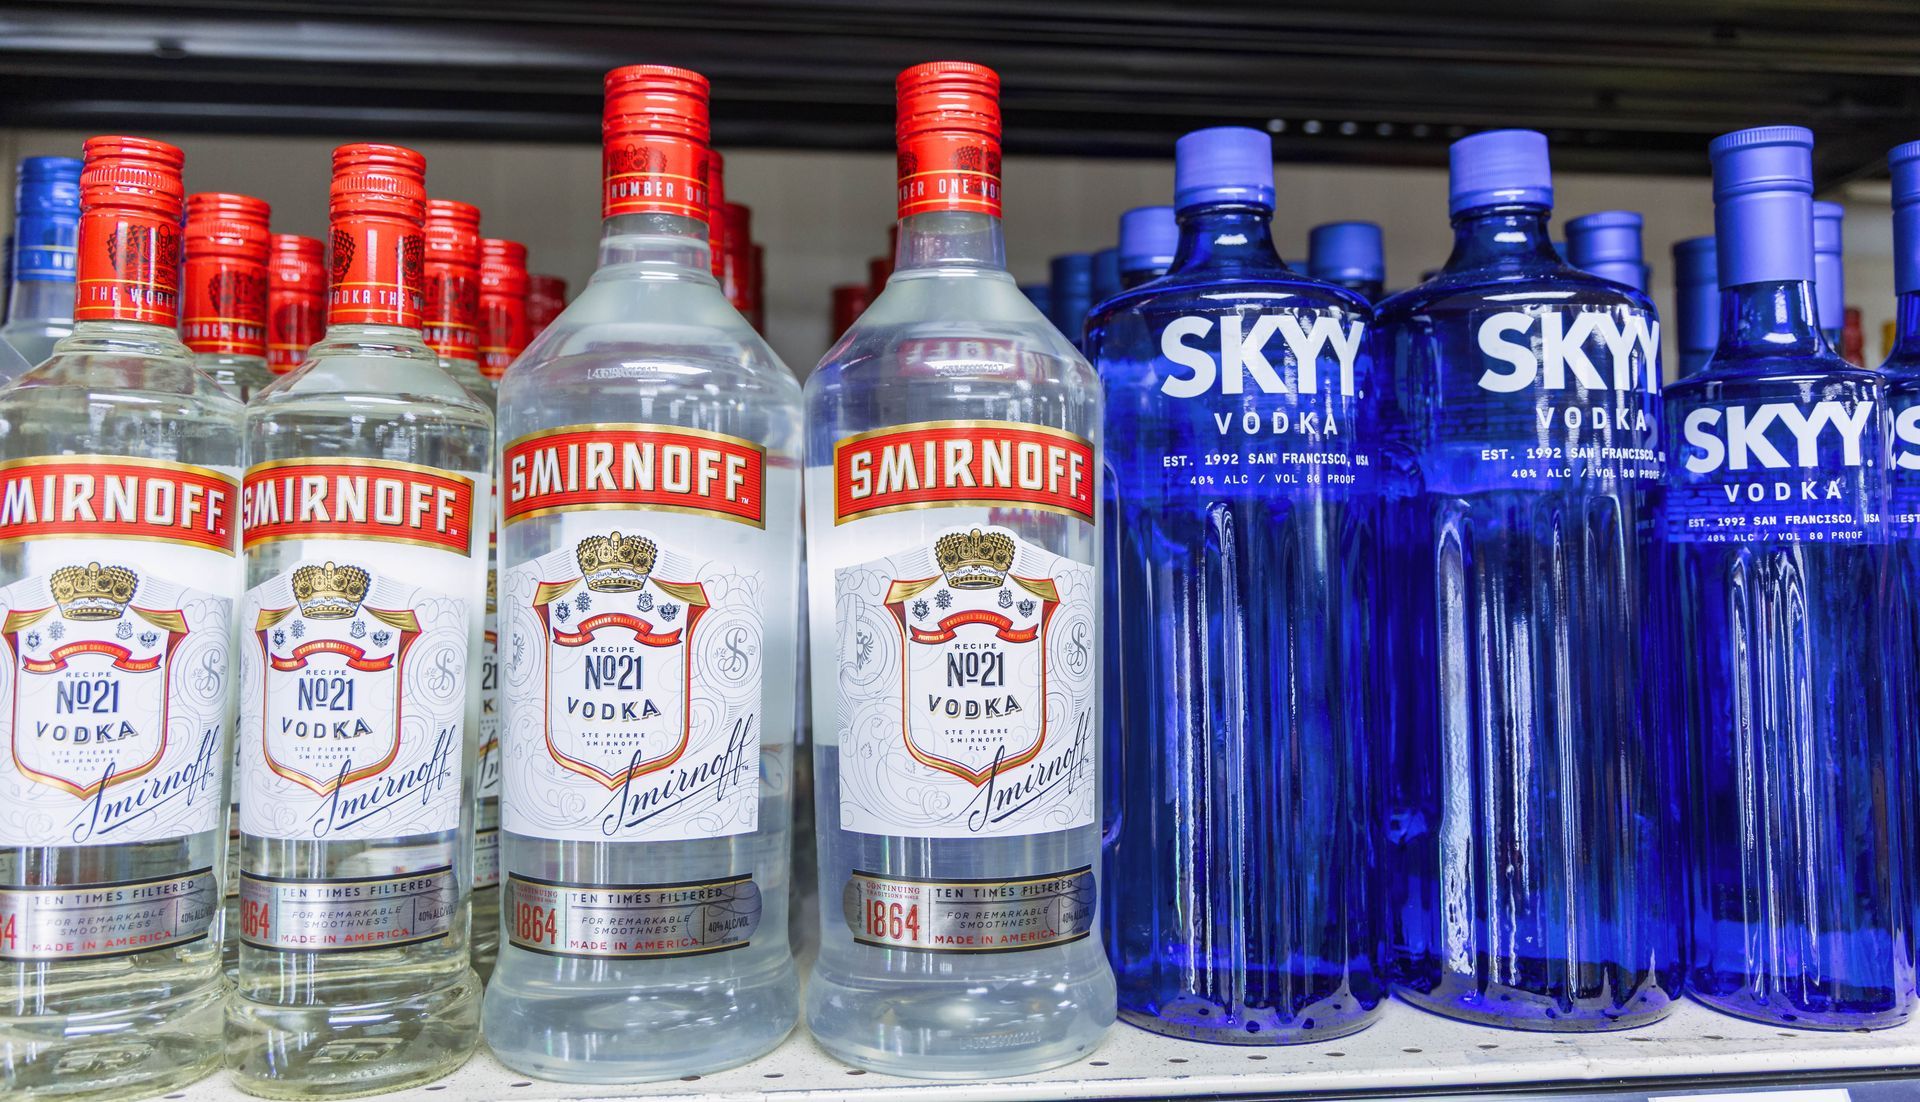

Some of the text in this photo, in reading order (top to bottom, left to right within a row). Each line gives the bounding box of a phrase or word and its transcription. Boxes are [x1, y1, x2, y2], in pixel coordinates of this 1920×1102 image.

[612, 181, 673, 198] NUMBER
[939, 178, 968, 194] ONE
[91, 286, 118, 301] THE
[380, 290, 405, 307] THE
[1161, 314, 1365, 398] SKYY
[1477, 311, 1660, 394] SKYY
[1214, 412, 1338, 435] VODKA
[1536, 407, 1647, 431] VODKA
[1683, 401, 1873, 474] SKYY
[1164, 453, 1369, 467] EST. 1992 SAN FRANCISCO, USA
[1481, 449, 1515, 461] EST.
[1526, 448, 1562, 459] 1992
[1570, 448, 1595, 459] SAN
[1602, 448, 1657, 463] FRANCISCO,
[512, 442, 746, 503] SMIRNOFF
[851, 439, 1084, 500] SMIRNOFF
[1511, 469, 1537, 478] 40%
[1547, 469, 1571, 478] ALC
[1595, 469, 1616, 478] VOL
[1623, 469, 1635, 479] 80
[1639, 469, 1660, 480] PROOF
[1190, 474, 1355, 485] 40% ALC / VOL 80 PROOF
[1724, 481, 1842, 502] VODKA
[243, 475, 456, 533] SMIRNOFF
[1688, 513, 1880, 528] EST. 1992 SAN FRANCISCO, USA
[1707, 534, 1726, 543] 40%
[1733, 533, 1755, 542] ALC
[1779, 532, 1801, 541] VOL
[1810, 532, 1823, 540] 80
[1832, 531, 1863, 540] PROOF
[567, 697, 661, 721] VODKA
[928, 694, 1022, 719] VODKA
[36, 720, 138, 744] VODKA
[282, 717, 373, 740] VODKA
[597, 714, 756, 836] Smirnoff
[961, 707, 1091, 831] Smirnoff
[65, 725, 220, 843] Smirnoff
[306, 725, 457, 838] Smirnoff
[35, 880, 195, 905] TEN TIMES FILTERED
[282, 888, 307, 898] TEN
[317, 888, 360, 898] TIMES
[370, 879, 432, 896] FILTERED
[572, 888, 722, 903] TEN TIMES FILTERED
[866, 881, 920, 894] CONTINUING
[936, 880, 1072, 898] TEN TIMES FILTERED
[79, 908, 165, 924] REMARKABLE
[319, 906, 402, 919] REMARKABLE
[582, 915, 690, 926] FOR REMARKABLE
[866, 899, 920, 941] 1864
[975, 907, 1049, 919] REMARKABLE
[60, 919, 151, 936] SMOOTHNESS
[304, 916, 388, 928] SMOOTHNESS
[517, 901, 557, 944] 1864
[594, 925, 677, 935] SMOOTHNESS
[960, 918, 1037, 929] SMOOTHNESS
[32, 930, 172, 951] MADE IN AMERICA
[281, 929, 409, 943] MADE IN AMERICA
[570, 938, 699, 950] MADE IN AMERICA
[935, 928, 1055, 944] MADE IN AMERICA
